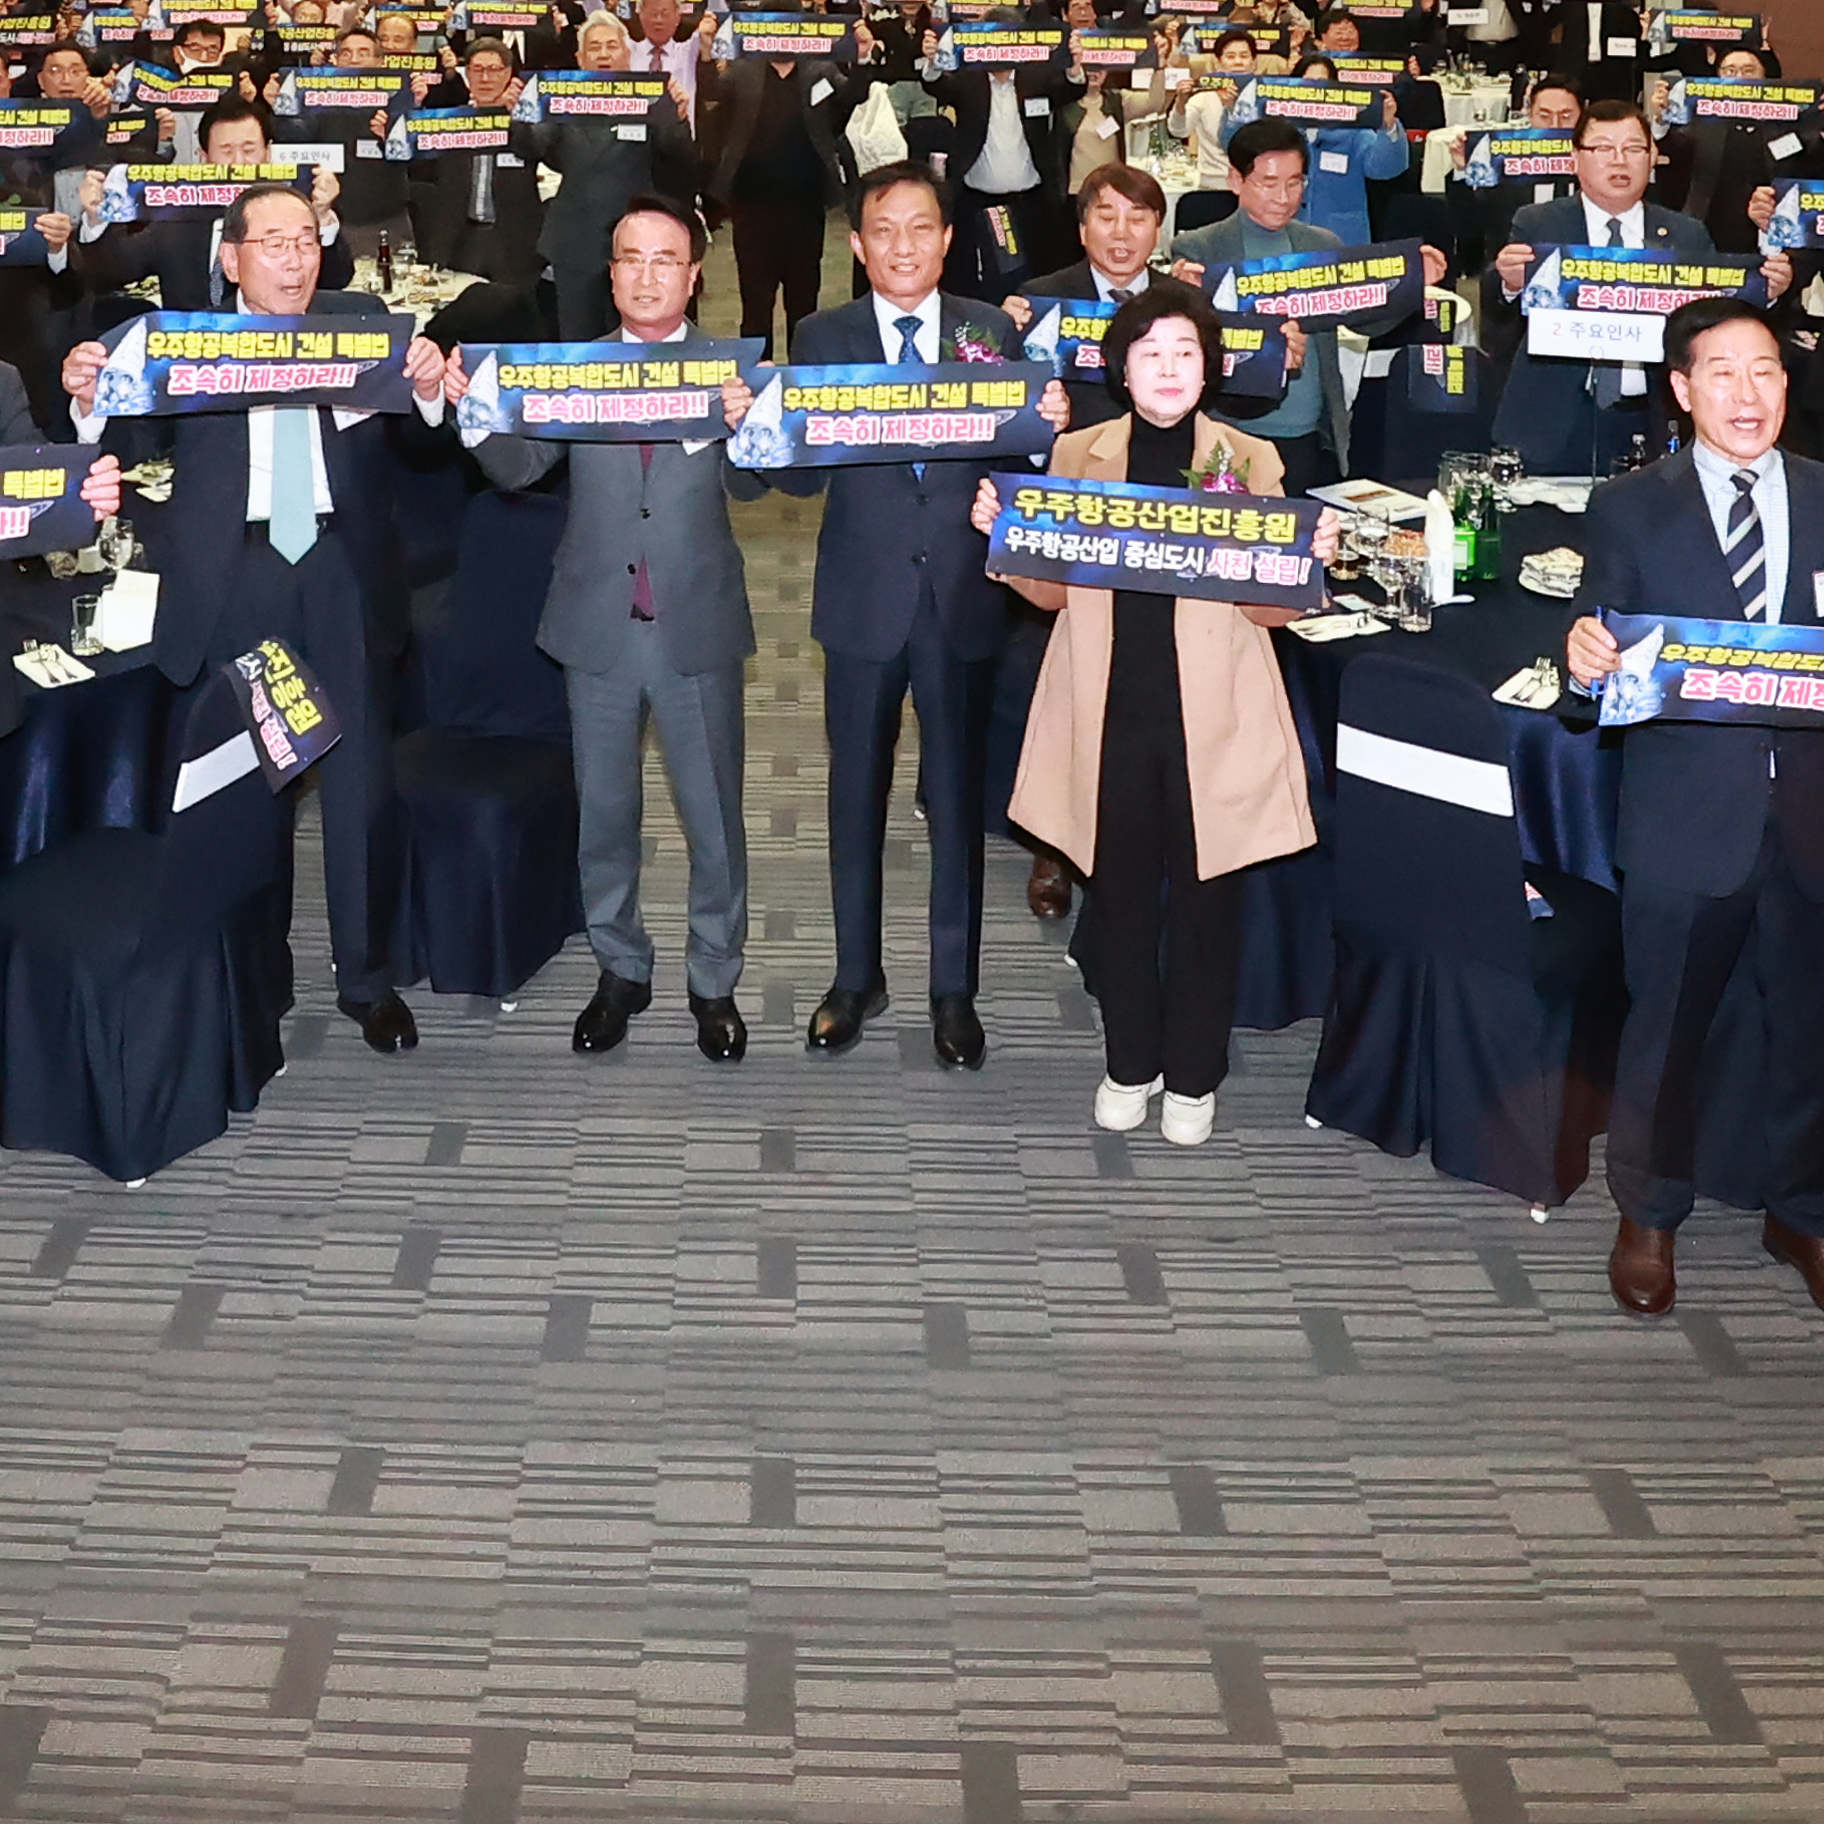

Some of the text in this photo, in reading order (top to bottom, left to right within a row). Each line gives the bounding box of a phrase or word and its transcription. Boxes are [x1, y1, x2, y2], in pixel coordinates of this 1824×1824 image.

[148, 333, 389, 358] 우주항공복합도시 건설 특별법
[1552, 321, 1643, 343] 2 주요인사
[167, 357, 366, 395] 조속히 제정하라!!
[500, 362, 733, 387] 우주항공복합도시 건설 특별법
[522, 386, 717, 423] 조속히 제정하라!!
[784, 380, 1025, 410] 우주항공복합도시 건설 특별법
[805, 410, 1004, 446] 조속히 제정하라!!
[2, 469, 65, 497] 특별법
[1014, 492, 1296, 542] 우주항공산업진흥원
[1004, 526, 1313, 585] 우주항공산업 중심도시 사천 설립!
[1679, 667, 1779, 705] 조속히
[259, 714, 298, 771] 설립!
